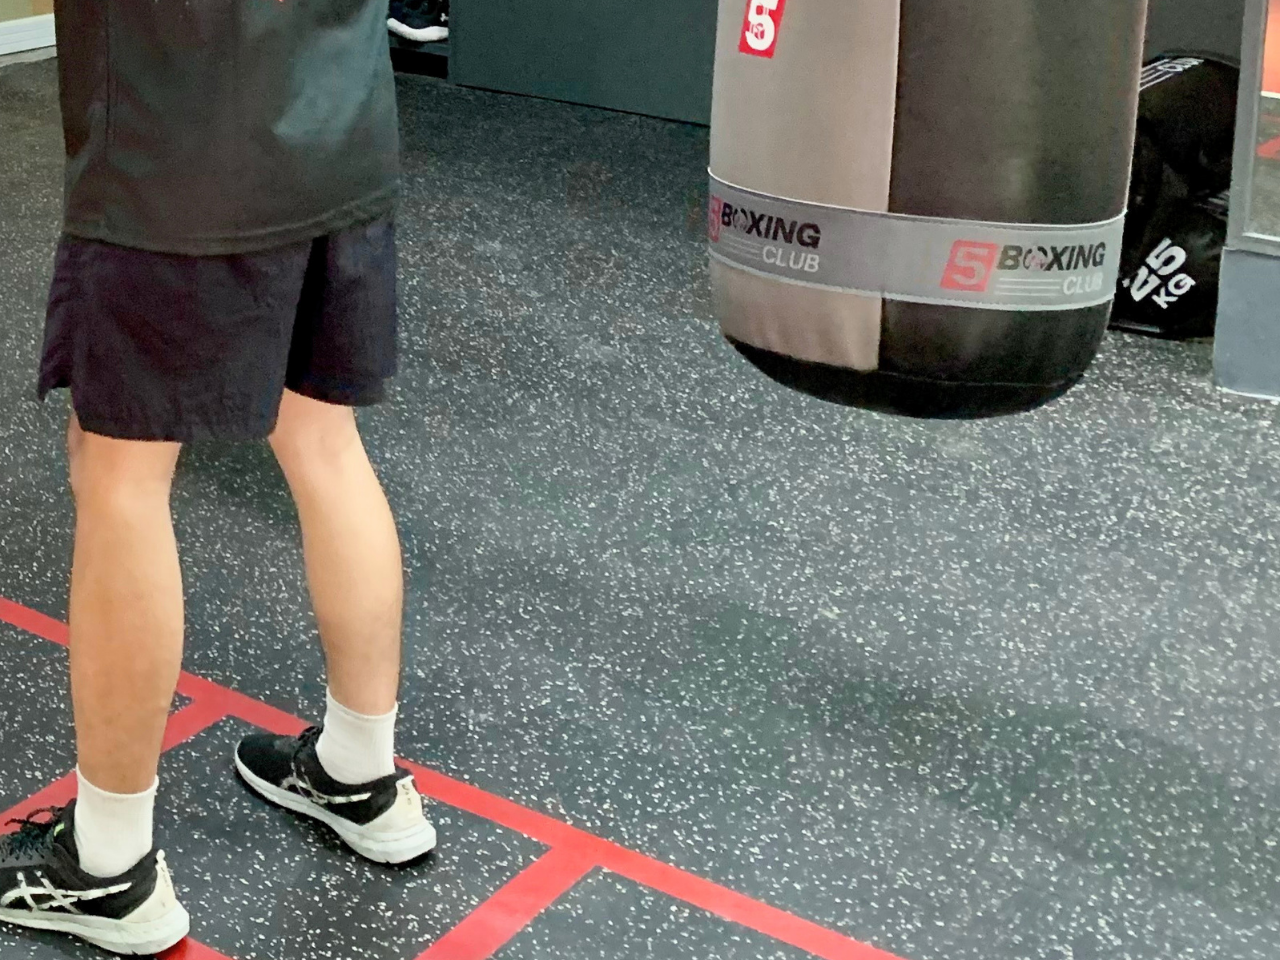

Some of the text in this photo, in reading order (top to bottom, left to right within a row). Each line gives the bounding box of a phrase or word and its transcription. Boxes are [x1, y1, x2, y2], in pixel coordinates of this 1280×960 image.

[721, 202, 821, 249] BOXING
[762, 245, 820, 273] CLUB
[952, 242, 1106, 286] 5 BOXING
[1122, 238, 1187, 302] 25
[1063, 271, 1104, 295] CLUB
[1152, 273, 1196, 309] KG
